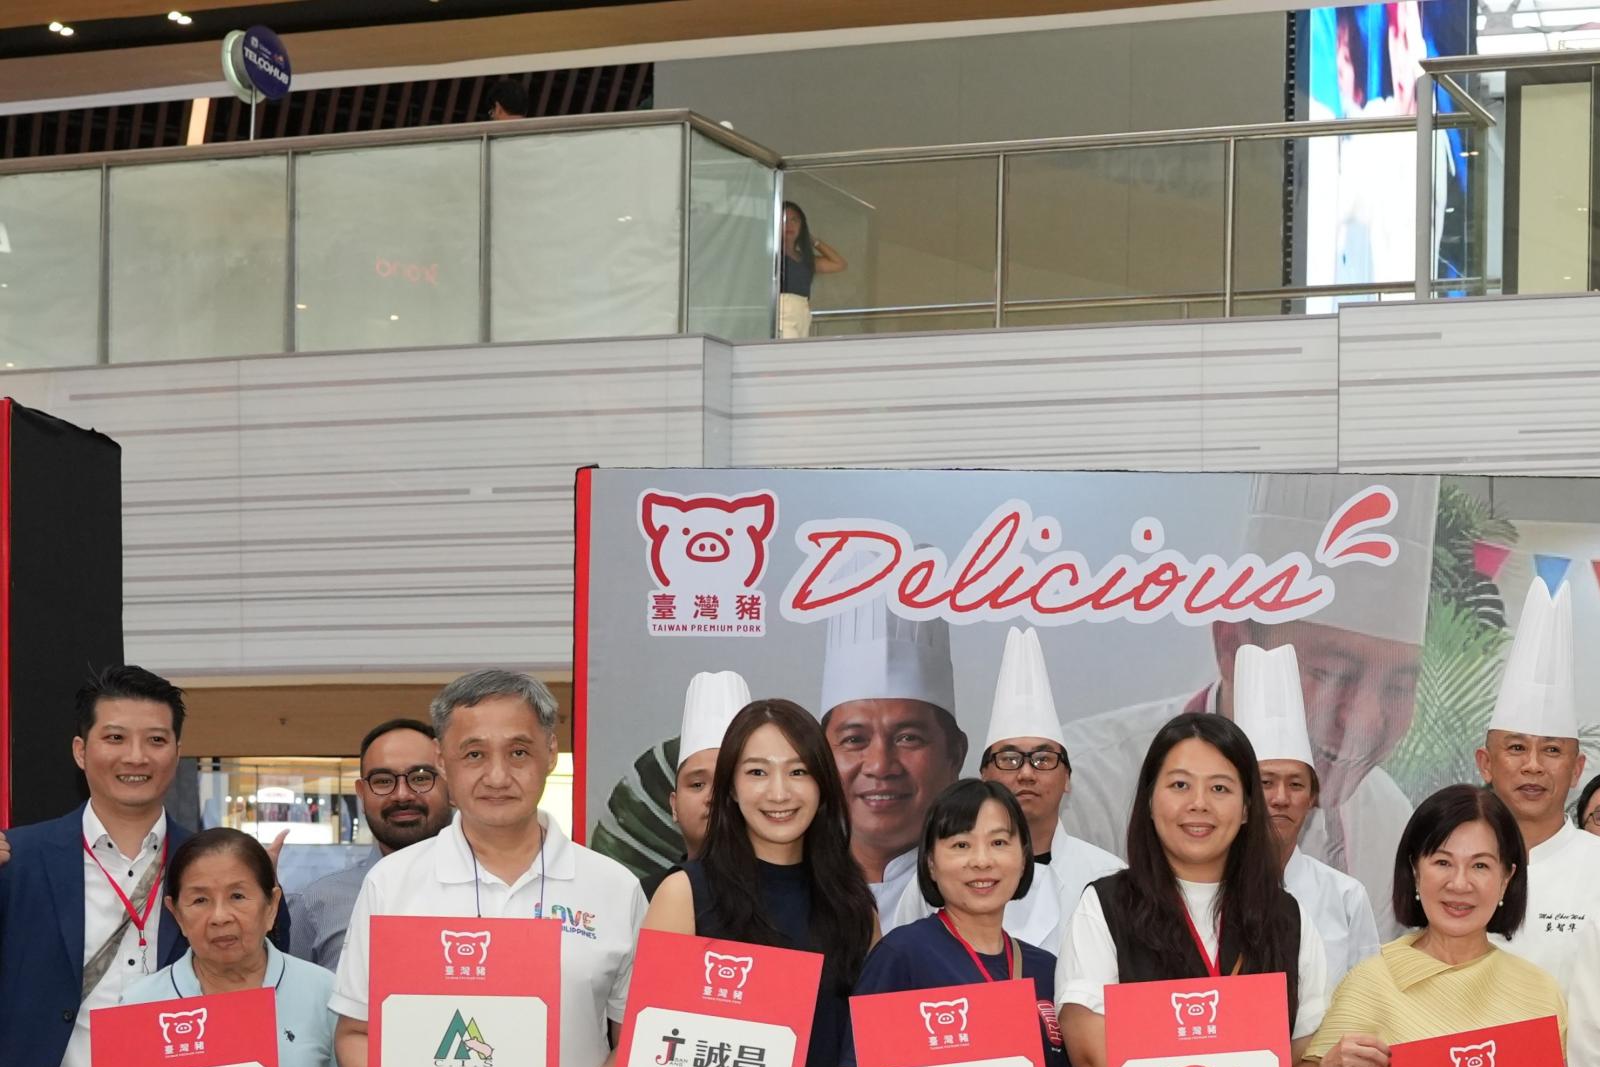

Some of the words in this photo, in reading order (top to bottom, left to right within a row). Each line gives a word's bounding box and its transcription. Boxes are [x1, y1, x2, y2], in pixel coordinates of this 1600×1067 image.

[791, 510, 1324, 614] Delicious
[652, 593, 761, 620] 臺灣豬
[652, 624, 688, 632] TAIWAN
[691, 624, 733, 632] PREMIUM
[736, 624, 761, 633] PORK
